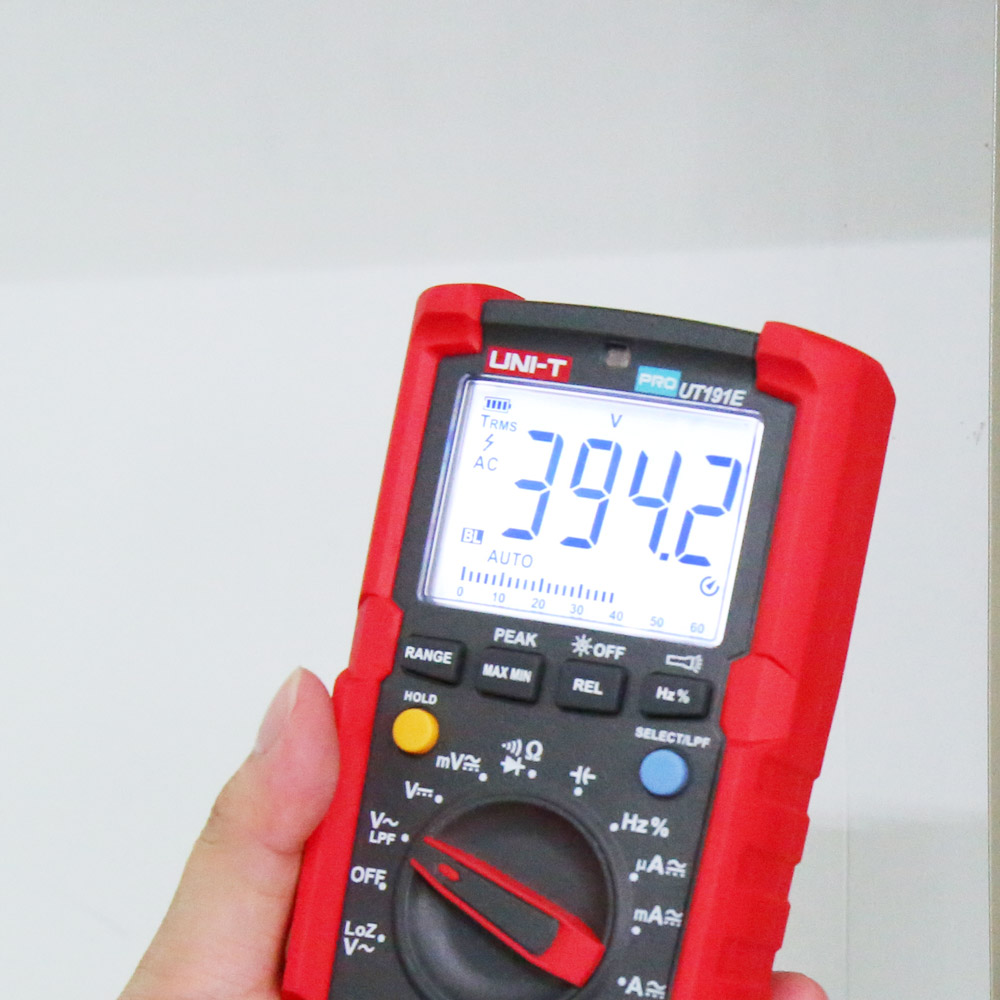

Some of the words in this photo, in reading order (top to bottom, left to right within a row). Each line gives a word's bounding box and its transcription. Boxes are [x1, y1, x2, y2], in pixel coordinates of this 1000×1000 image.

[488, 350, 568, 377] UNI-T
[637, 372, 679, 391] PRO
[678, 382, 748, 407] UT191E
[610, 413, 622, 428] V
[473, 455, 499, 471] AC
[501, 429, 742, 567] 394.2
[461, 528, 484, 545] BL
[487, 549, 533, 569] AUTO
[456, 586, 464, 598] 0
[492, 593, 506, 604] 10
[531, 597, 546, 610] 20
[569, 603, 584, 616] 30
[609, 610, 624, 622] 40
[650, 616, 664, 629] 50
[690, 621, 705, 634] 60
[494, 627, 538, 648] PEAK
[404, 645, 453, 665] RANGE
[592, 643, 627, 660] OFF
[482, 663, 509, 679] MAX
[509, 668, 533, 683] MIN
[572, 678, 604, 695] REL
[403, 690, 438, 705] HOLD
[634, 726, 711, 748] SELECT/LPF
[369, 830, 396, 845] LPF
[351, 866, 387, 885] OFF
[344, 921, 377, 939] LoZ
